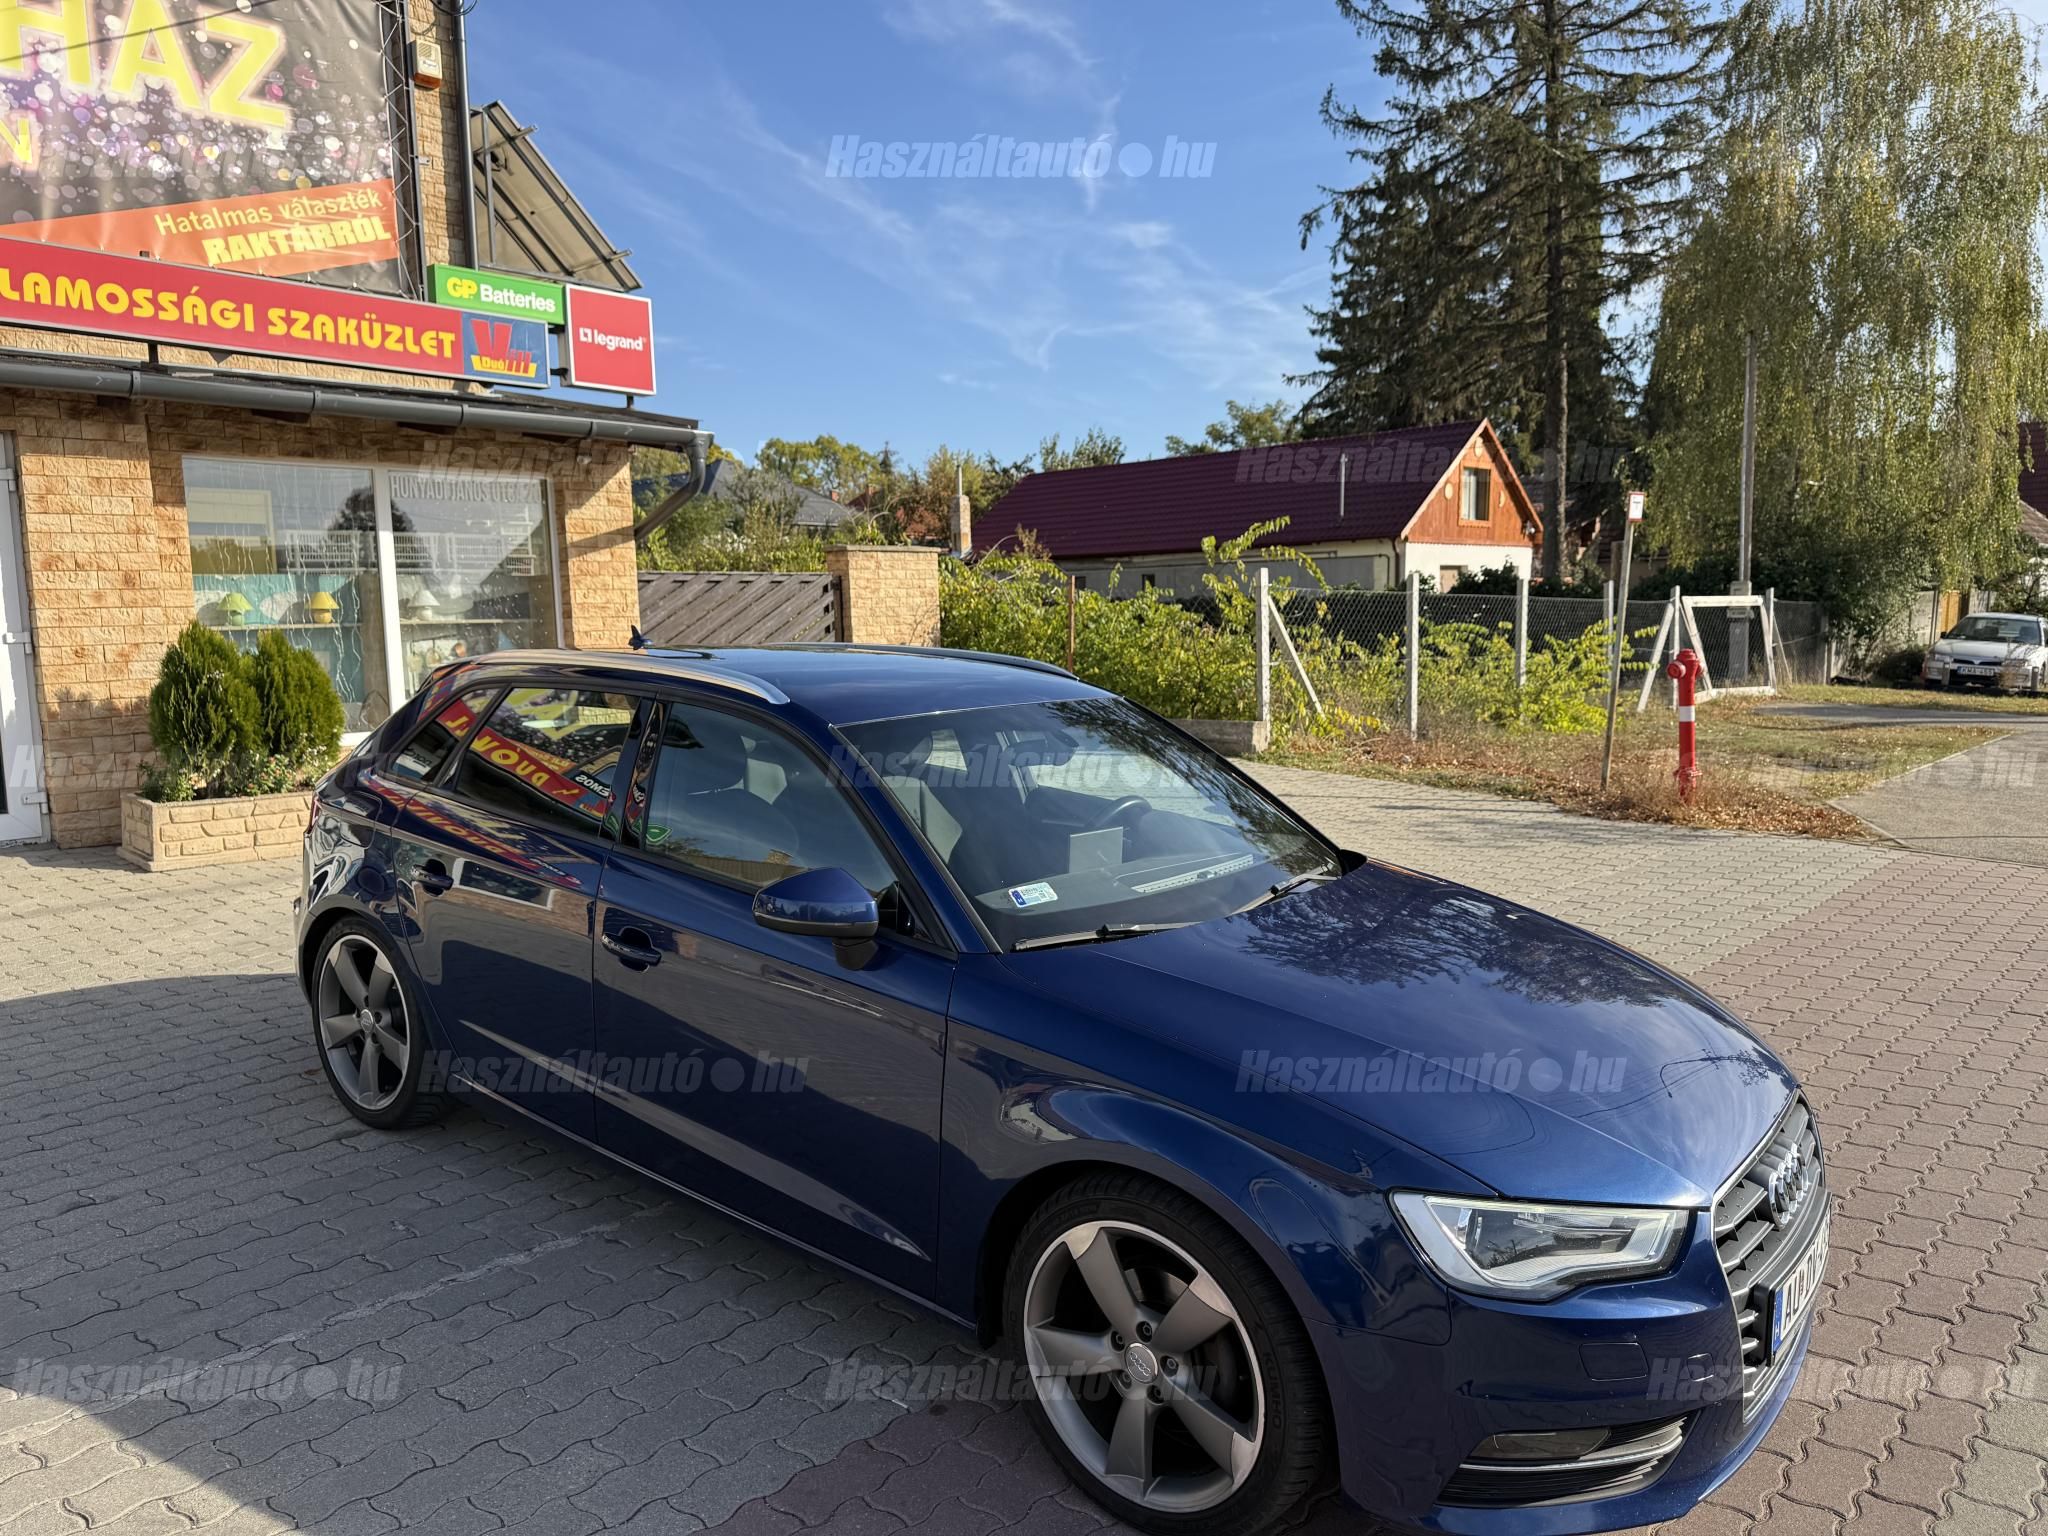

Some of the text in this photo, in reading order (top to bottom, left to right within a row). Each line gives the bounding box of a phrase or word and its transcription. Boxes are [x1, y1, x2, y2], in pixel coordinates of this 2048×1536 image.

[154, 188, 383, 236] Hatalmas választék
[202, 215, 392, 266] RAKTÁRRÓL
[0, 266, 456, 358] LAMOSSÁGI SZAKÜZLET
[479, 283, 556, 313] Batteries
